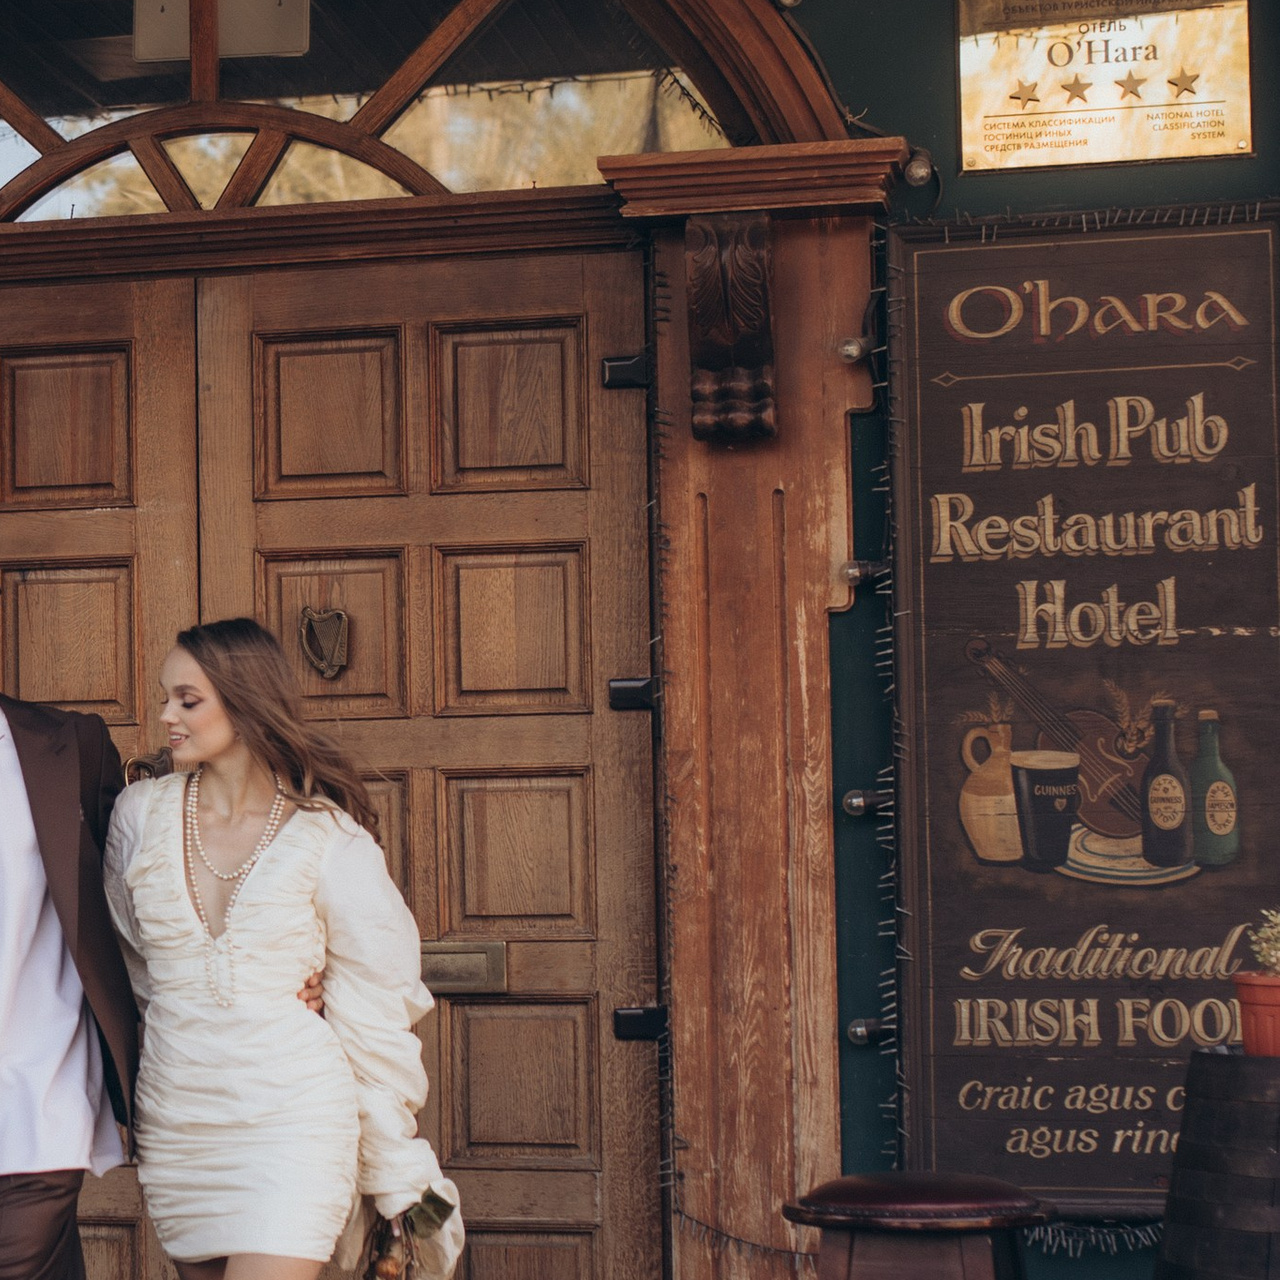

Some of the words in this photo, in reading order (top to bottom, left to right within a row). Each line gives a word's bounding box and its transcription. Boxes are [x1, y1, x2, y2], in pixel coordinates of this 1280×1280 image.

[1002, 3, 1059, 15] ОБЪЕКТОВ
[1078, 21, 1127, 34] ОТЕЛЬ
[1047, 39, 1159, 67] O'Hara
[1146, 111, 1193, 120] NATIONAL
[1196, 109, 1225, 117] HOTEL
[983, 121, 1026, 131] СИСТЕМА
[1028, 116, 1115, 128] КЛАССИФИКАЦИИ
[1152, 120, 1225, 131] CLASSIFICATION
[983, 131, 1033, 142] ГОСТИНИЦ
[1044, 129, 1072, 138] ИНЫХ
[1191, 131, 1226, 140] SYSTEM
[983, 144, 1022, 152] СРЕДСТВ
[1024, 139, 1088, 150] РАЗМЕЩЕНИЯ
[961, 399, 1102, 473] Irish
[1107, 392, 1230, 467] Pub
[929, 483, 1264, 563] Restaurant
[1015, 576, 1180, 649] Hotel
[1152, 778, 1178, 791] EXTRA
[1150, 796, 1182, 804] GUINNESS
[960, 923, 1253, 982] Traditional
[953, 998, 1103, 1047] IRISH
[958, 1076, 1055, 1111] Craic
[1064, 1082, 1156, 1114] agus
[1005, 1125, 1099, 1158] agus
[1112, 1120, 1180, 1154] rin
